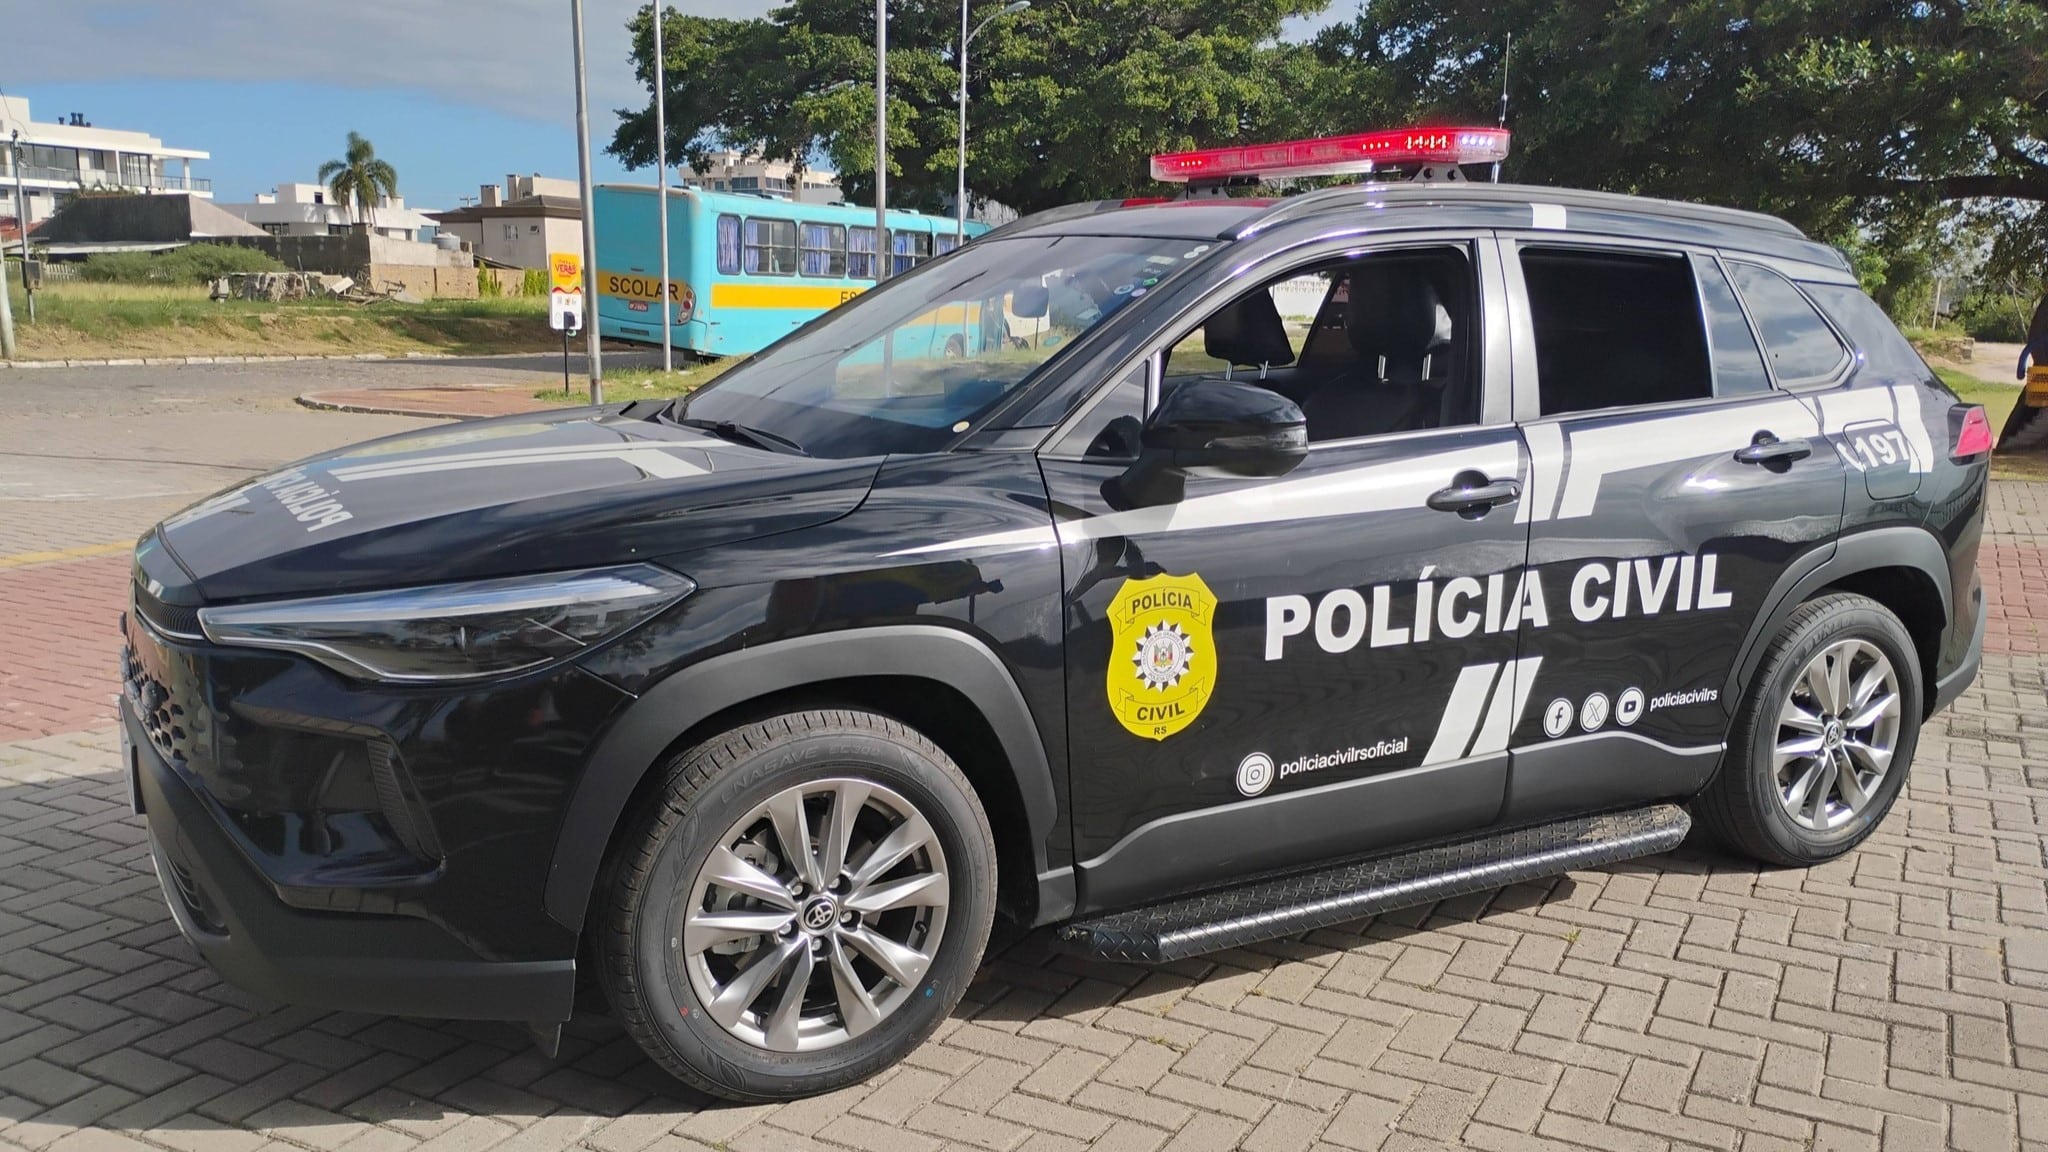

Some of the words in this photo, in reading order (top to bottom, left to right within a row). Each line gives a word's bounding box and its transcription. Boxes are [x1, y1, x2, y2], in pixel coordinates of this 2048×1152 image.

[1855, 430, 1909, 467] 197
[1132, 589, 1193, 614] POLÍCIA
[1265, 565, 1549, 661] POLÍCIA
[1570, 554, 1732, 622] CIVIL
[1137, 703, 1185, 721] CIVIL
[1650, 688, 1718, 712] policiacivilrs
[1154, 726, 1167, 735] RS
[1280, 736, 1408, 780] policiacivilrsoficial
